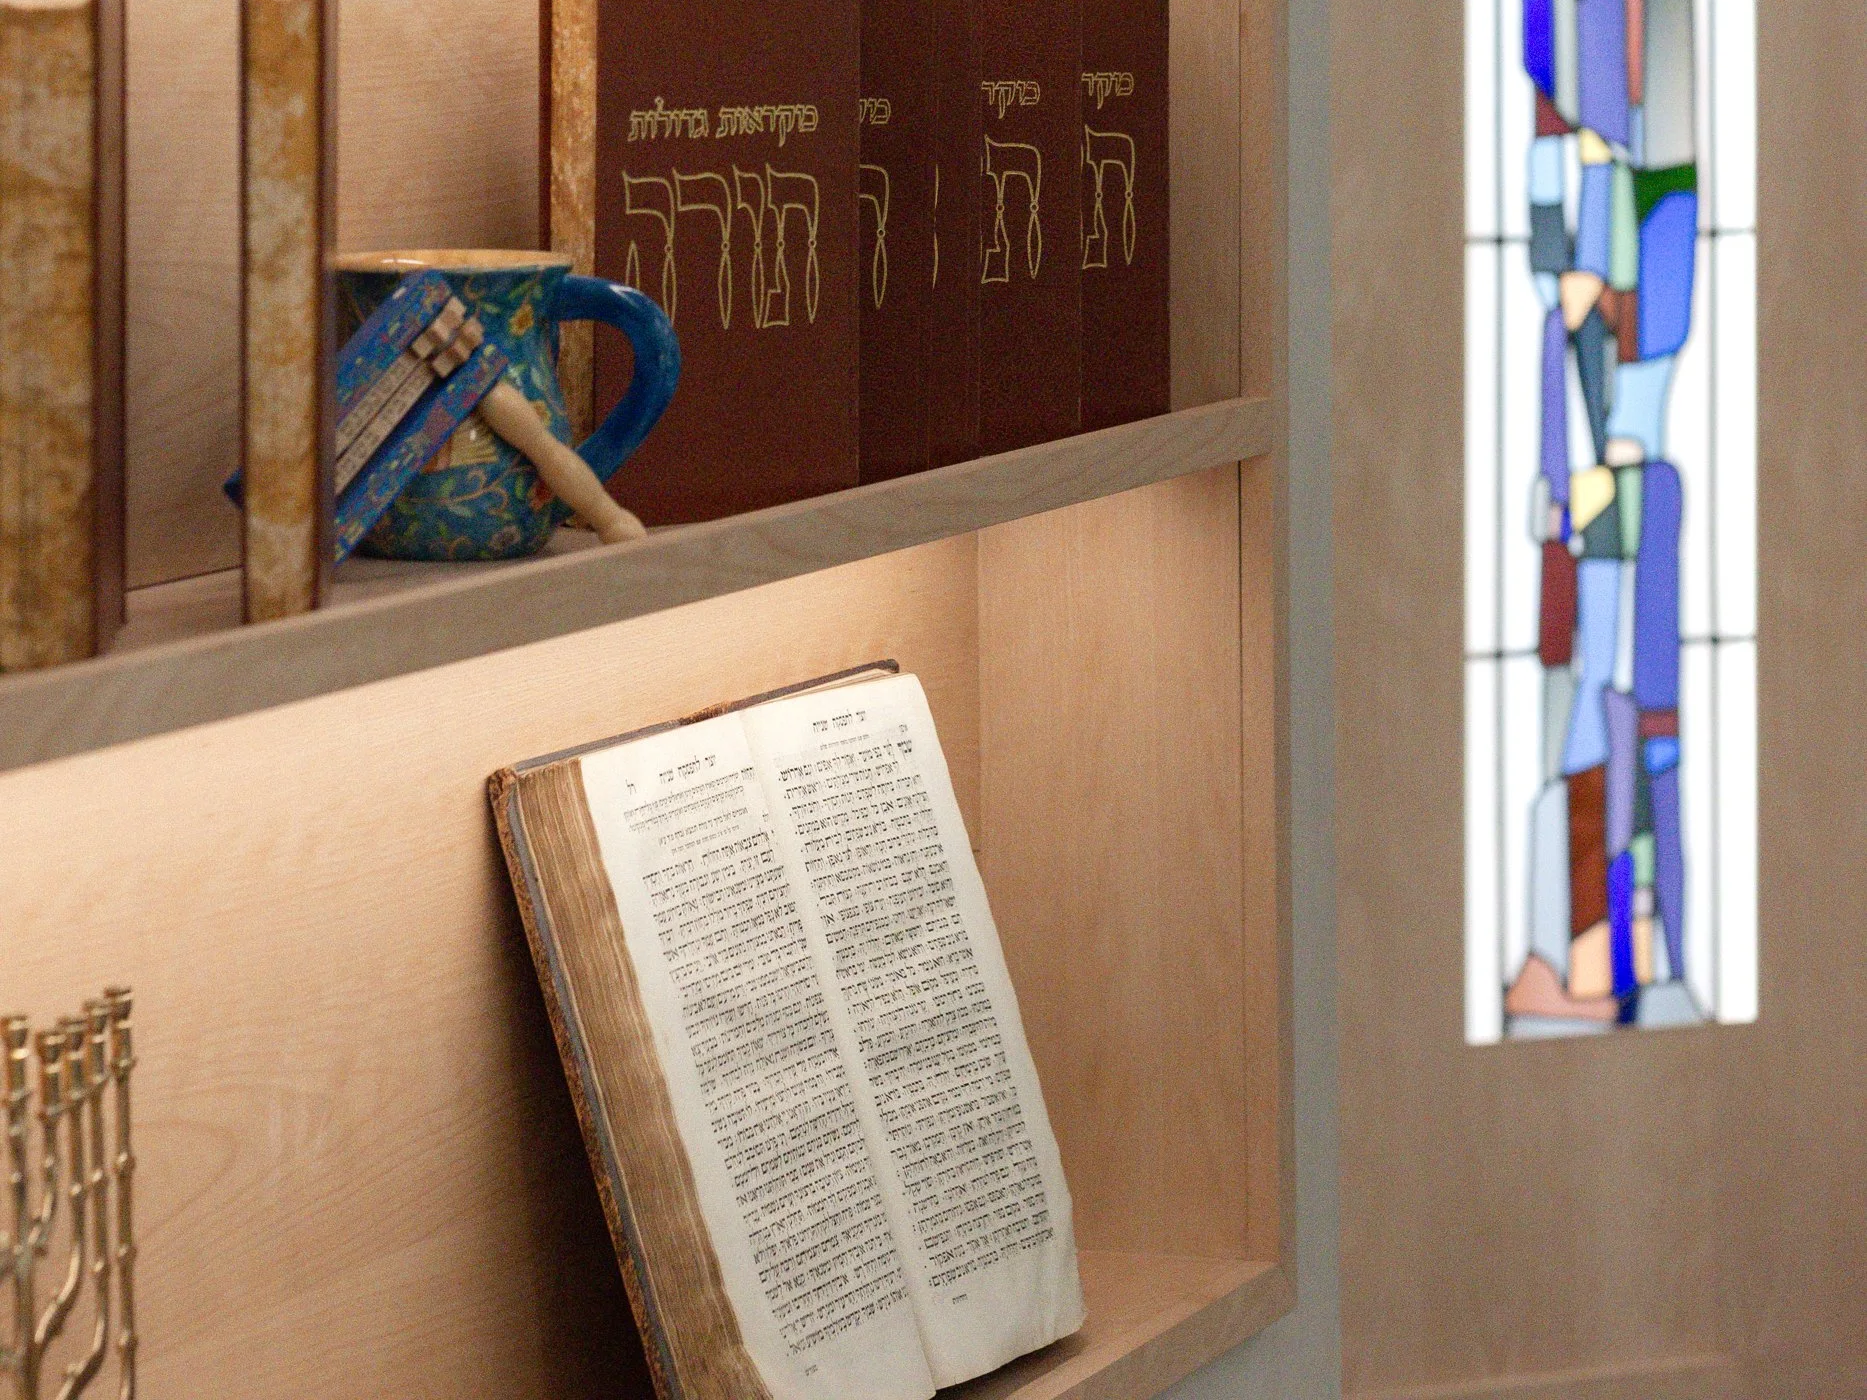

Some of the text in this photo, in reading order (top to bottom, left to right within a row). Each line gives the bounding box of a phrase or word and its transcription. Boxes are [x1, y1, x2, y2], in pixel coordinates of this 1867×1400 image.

[628, 96, 709, 142] גדולות
[716, 104, 819, 147] מקראות
[622, 163, 820, 331] תורה
